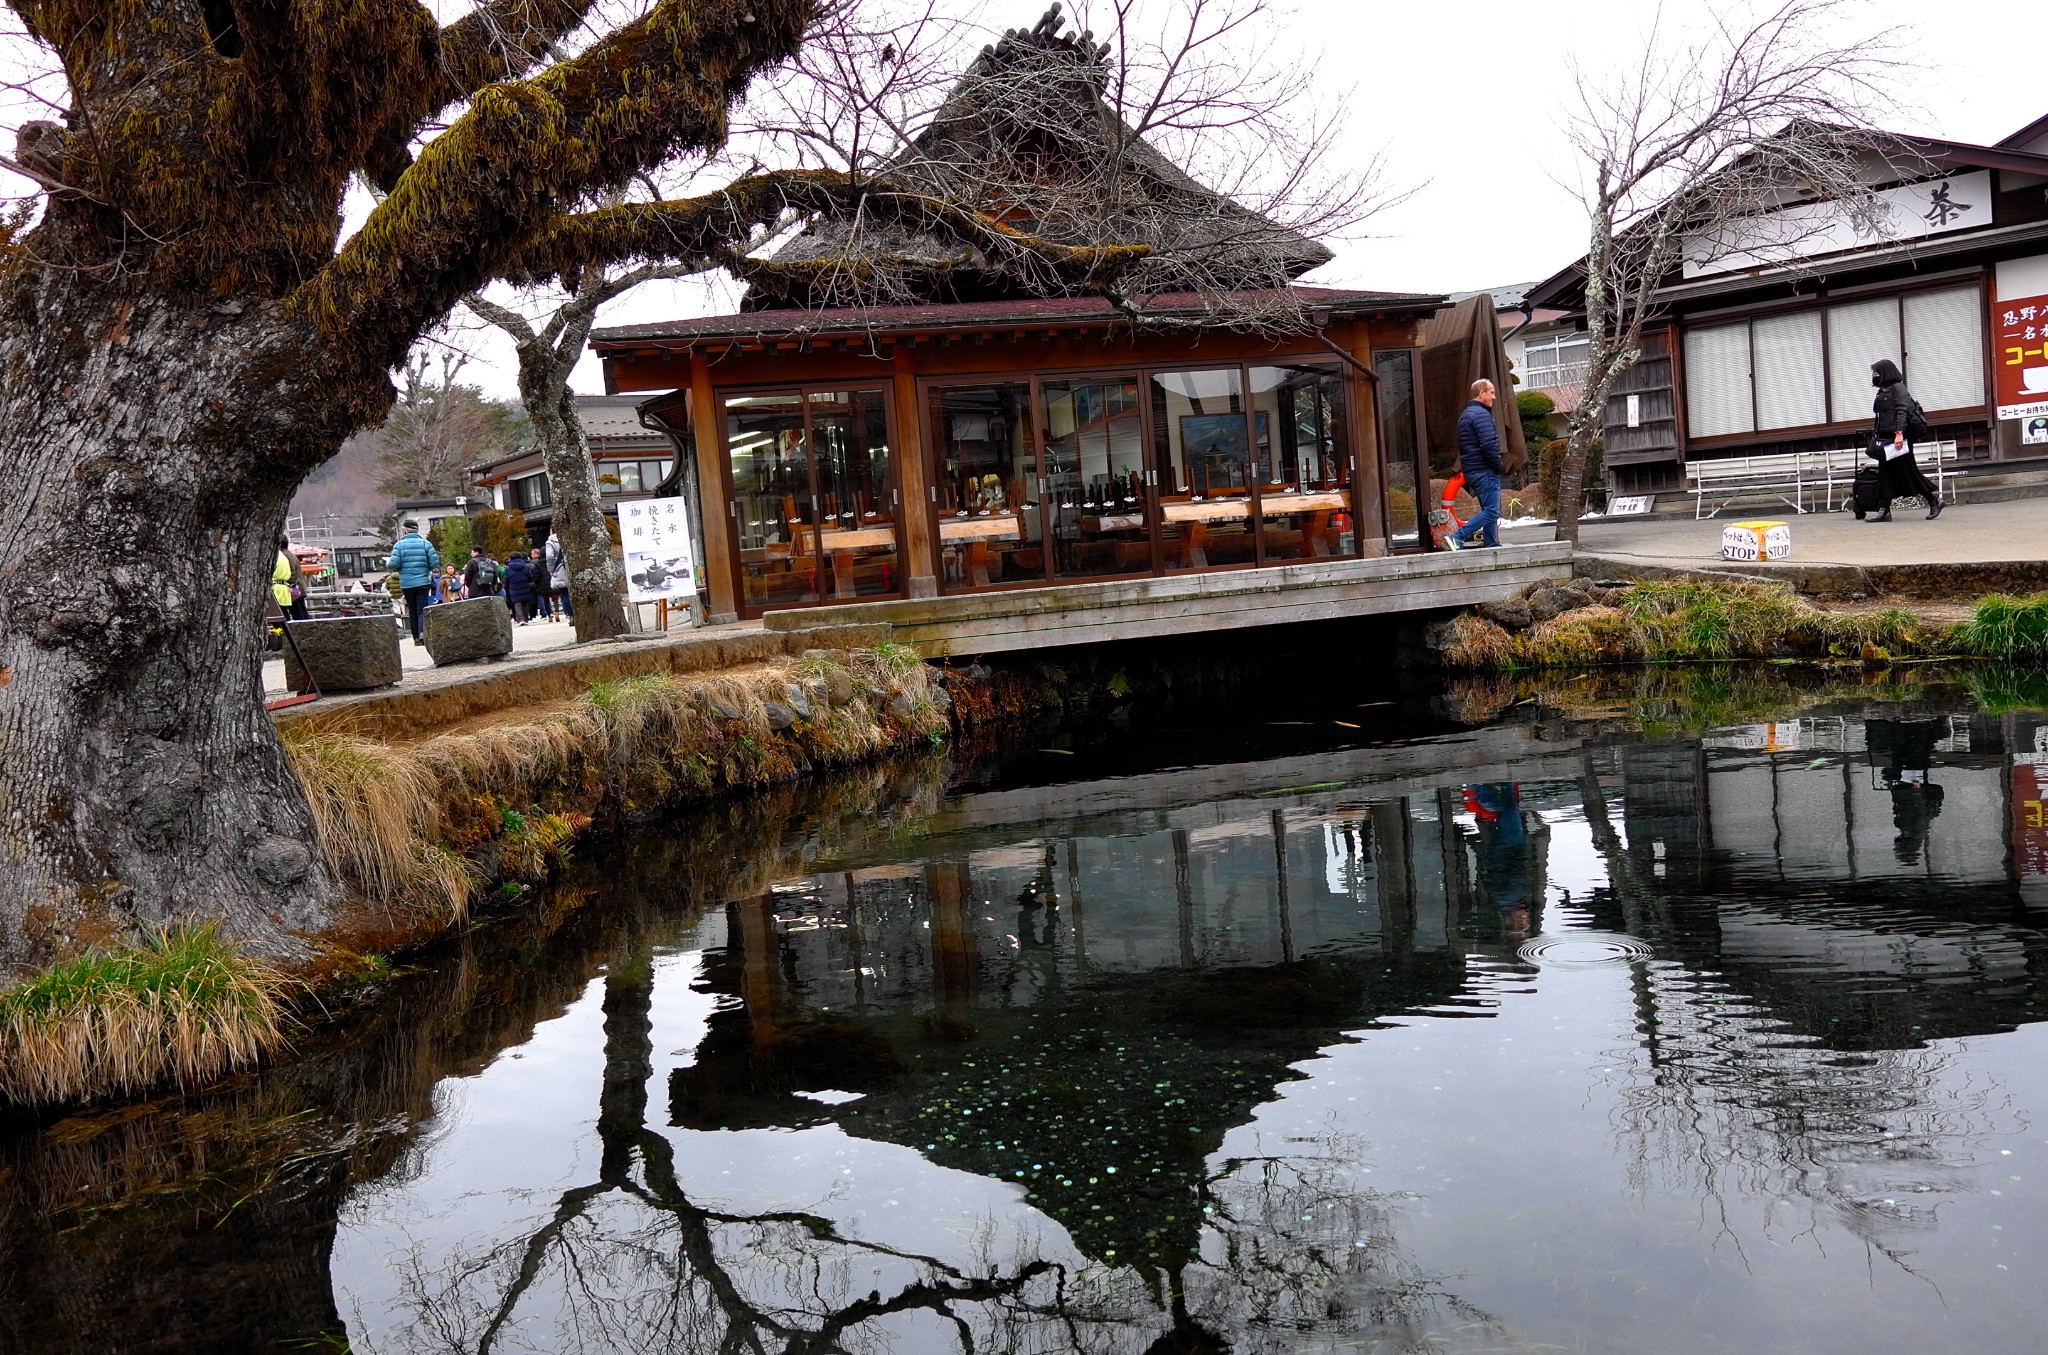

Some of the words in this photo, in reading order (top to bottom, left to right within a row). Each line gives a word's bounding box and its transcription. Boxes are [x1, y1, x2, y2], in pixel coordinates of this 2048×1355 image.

[665, 503, 678, 533] 名水
[1723, 545, 1755, 559] STOP
[1768, 544, 1789, 557] STOP
